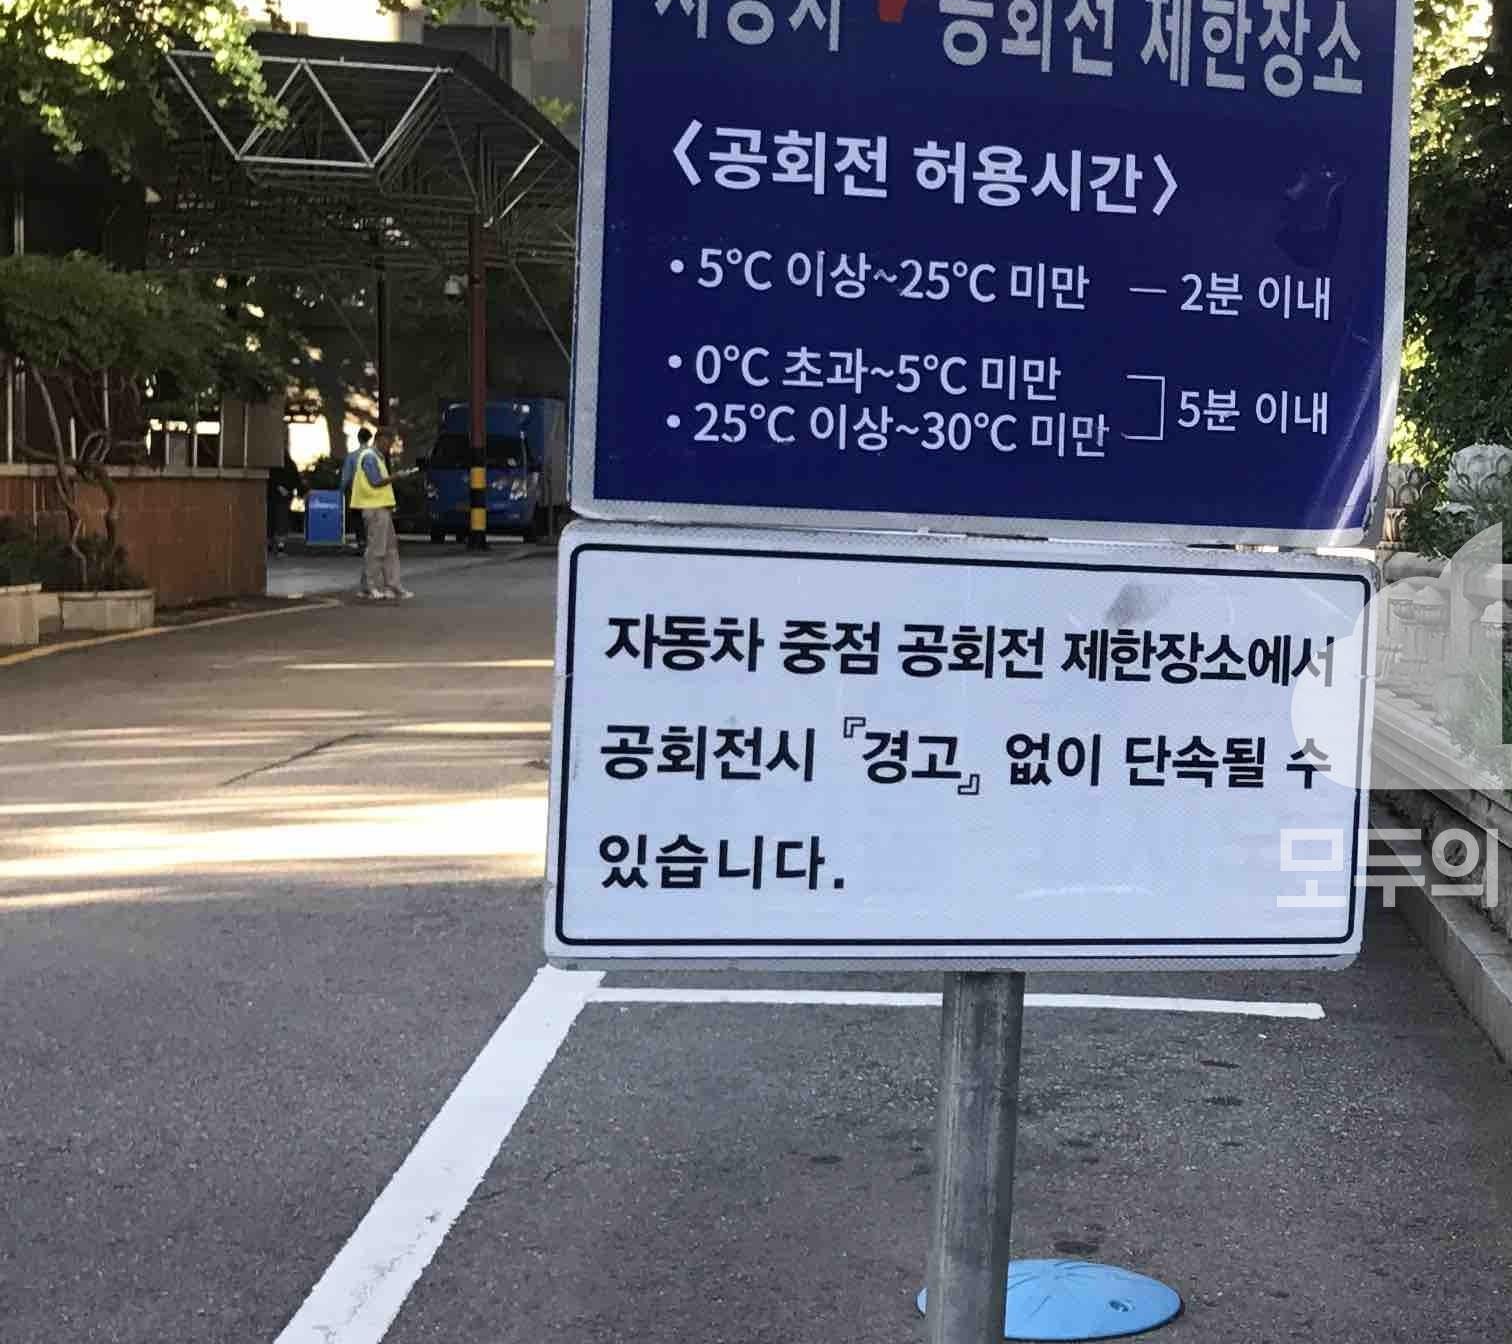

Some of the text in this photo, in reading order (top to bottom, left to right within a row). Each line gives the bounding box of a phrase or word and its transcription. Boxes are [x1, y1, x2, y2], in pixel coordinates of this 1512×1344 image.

[1011, 263, 1089, 309] 미만
[1181, 273, 1242, 315] 2분
[1259, 275, 1330, 320] 이내
[982, 356, 1061, 400] 미만
[1032, 413, 1109, 457] 미만
[1178, 390, 1327, 434] 5분 이내
[605, 614, 1334, 686] 자동차 중점 공회전 제한장소에서
[600, 725, 815, 782] 공회전시
[1006, 733, 1100, 786] 없이
[1126, 735, 1265, 788] 단속될
[1285, 738, 1333, 790] 수
[600, 835, 844, 890] 있습니다.
